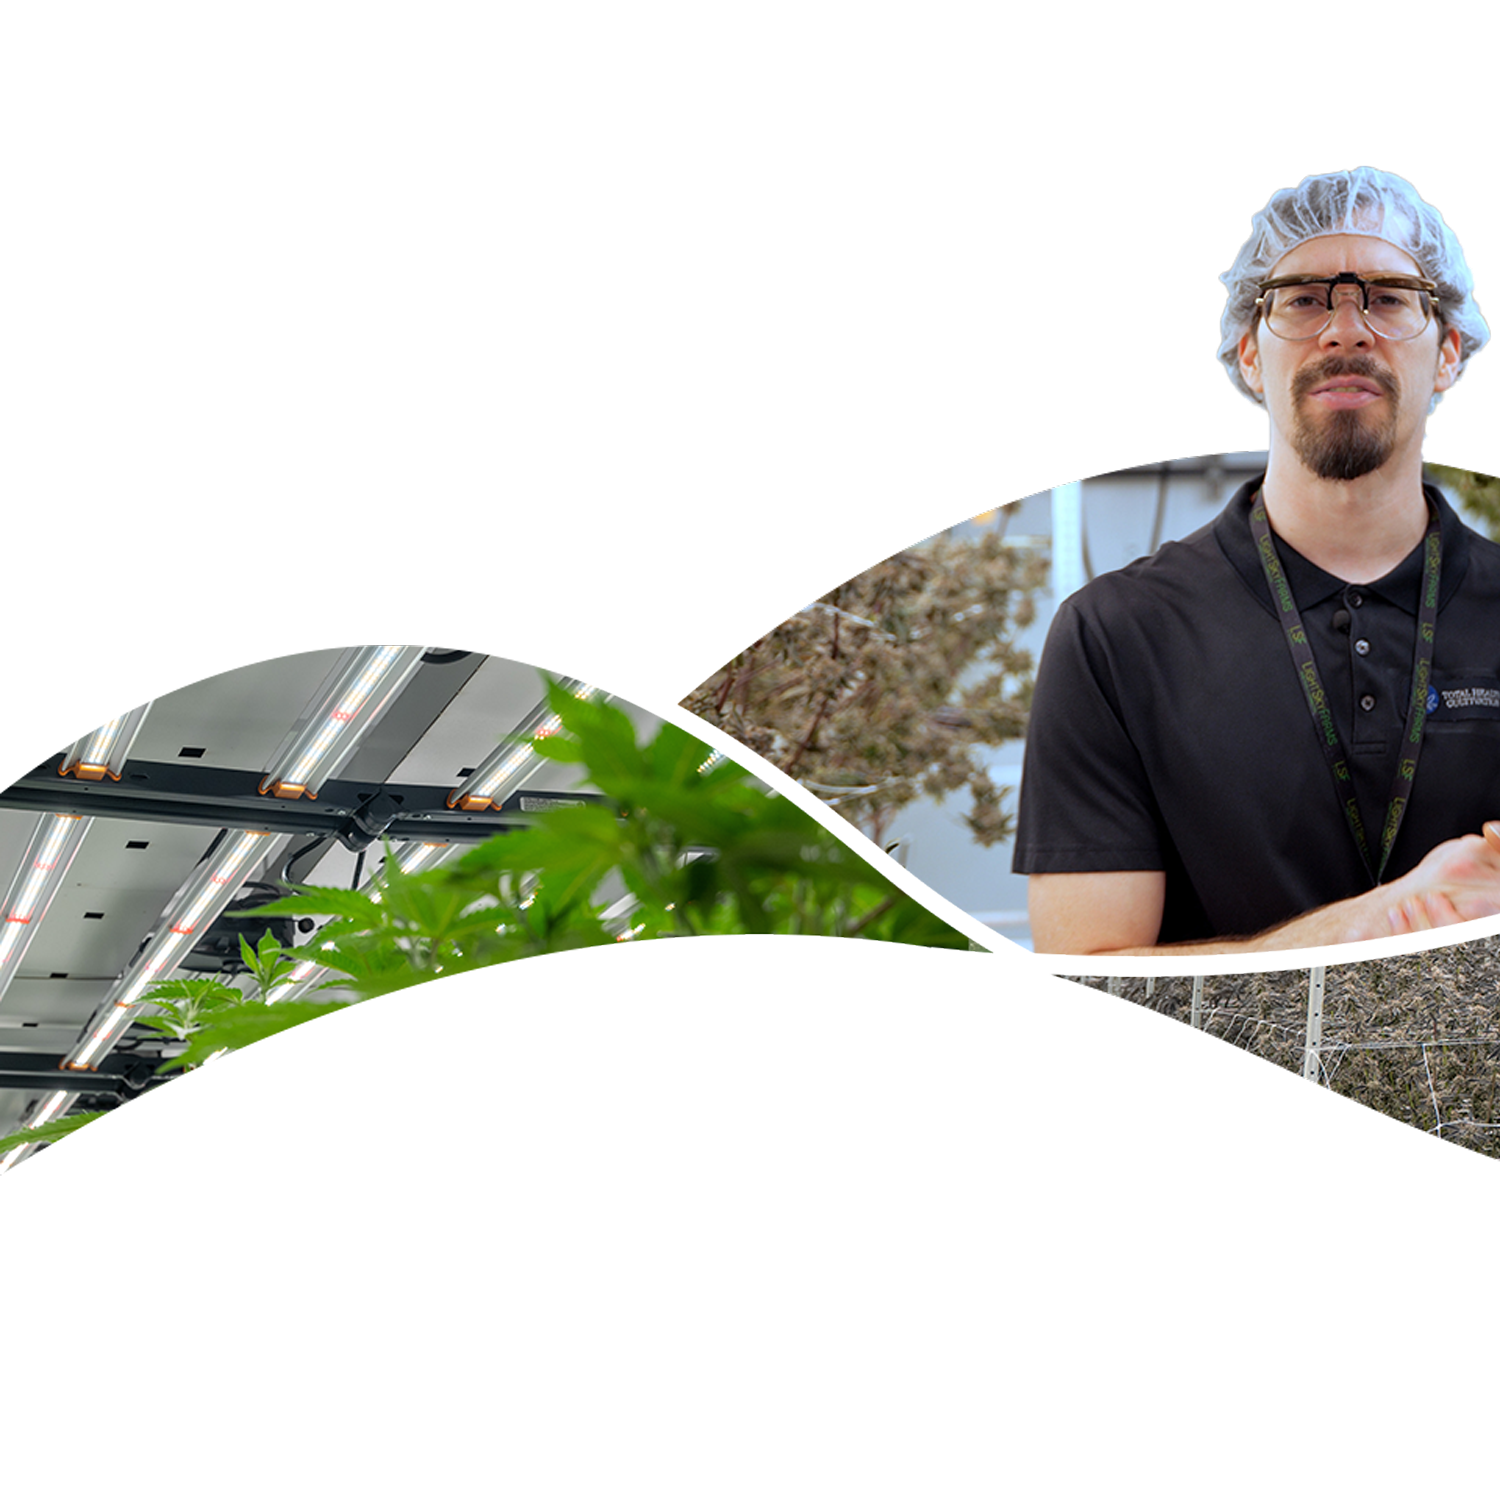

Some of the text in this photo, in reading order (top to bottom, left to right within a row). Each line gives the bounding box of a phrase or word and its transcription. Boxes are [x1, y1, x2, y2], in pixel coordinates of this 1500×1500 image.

[1289, 625, 1307, 645] LSF
[1422, 622, 1433, 643] LSF
[1442, 688, 1470, 700] TOTAL
[1334, 760, 1350, 781] LSF
[1400, 759, 1416, 781] LSF
